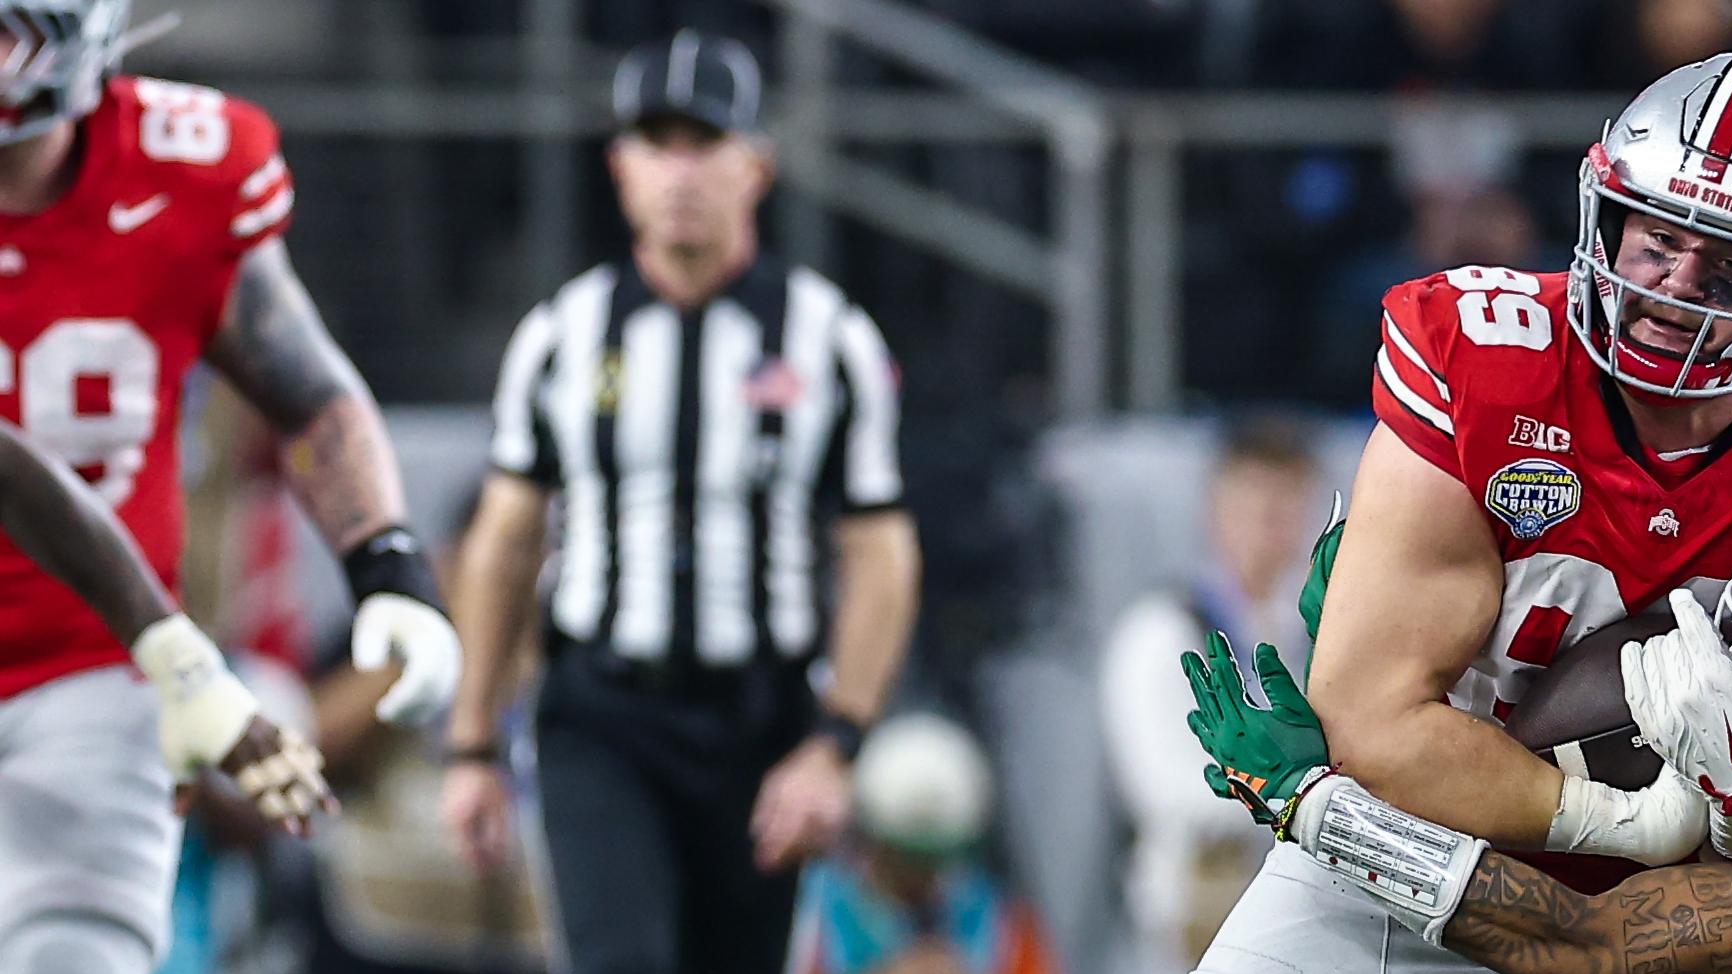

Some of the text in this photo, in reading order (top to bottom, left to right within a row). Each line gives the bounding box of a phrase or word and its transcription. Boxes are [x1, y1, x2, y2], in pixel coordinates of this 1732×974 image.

[1668, 177, 1699, 198] OHIO
[1445, 265, 1552, 351] 89
[0, 317, 160, 508] 9
[1495, 483, 1573, 512] COTTON
[1508, 499, 1558, 515] BOWL
